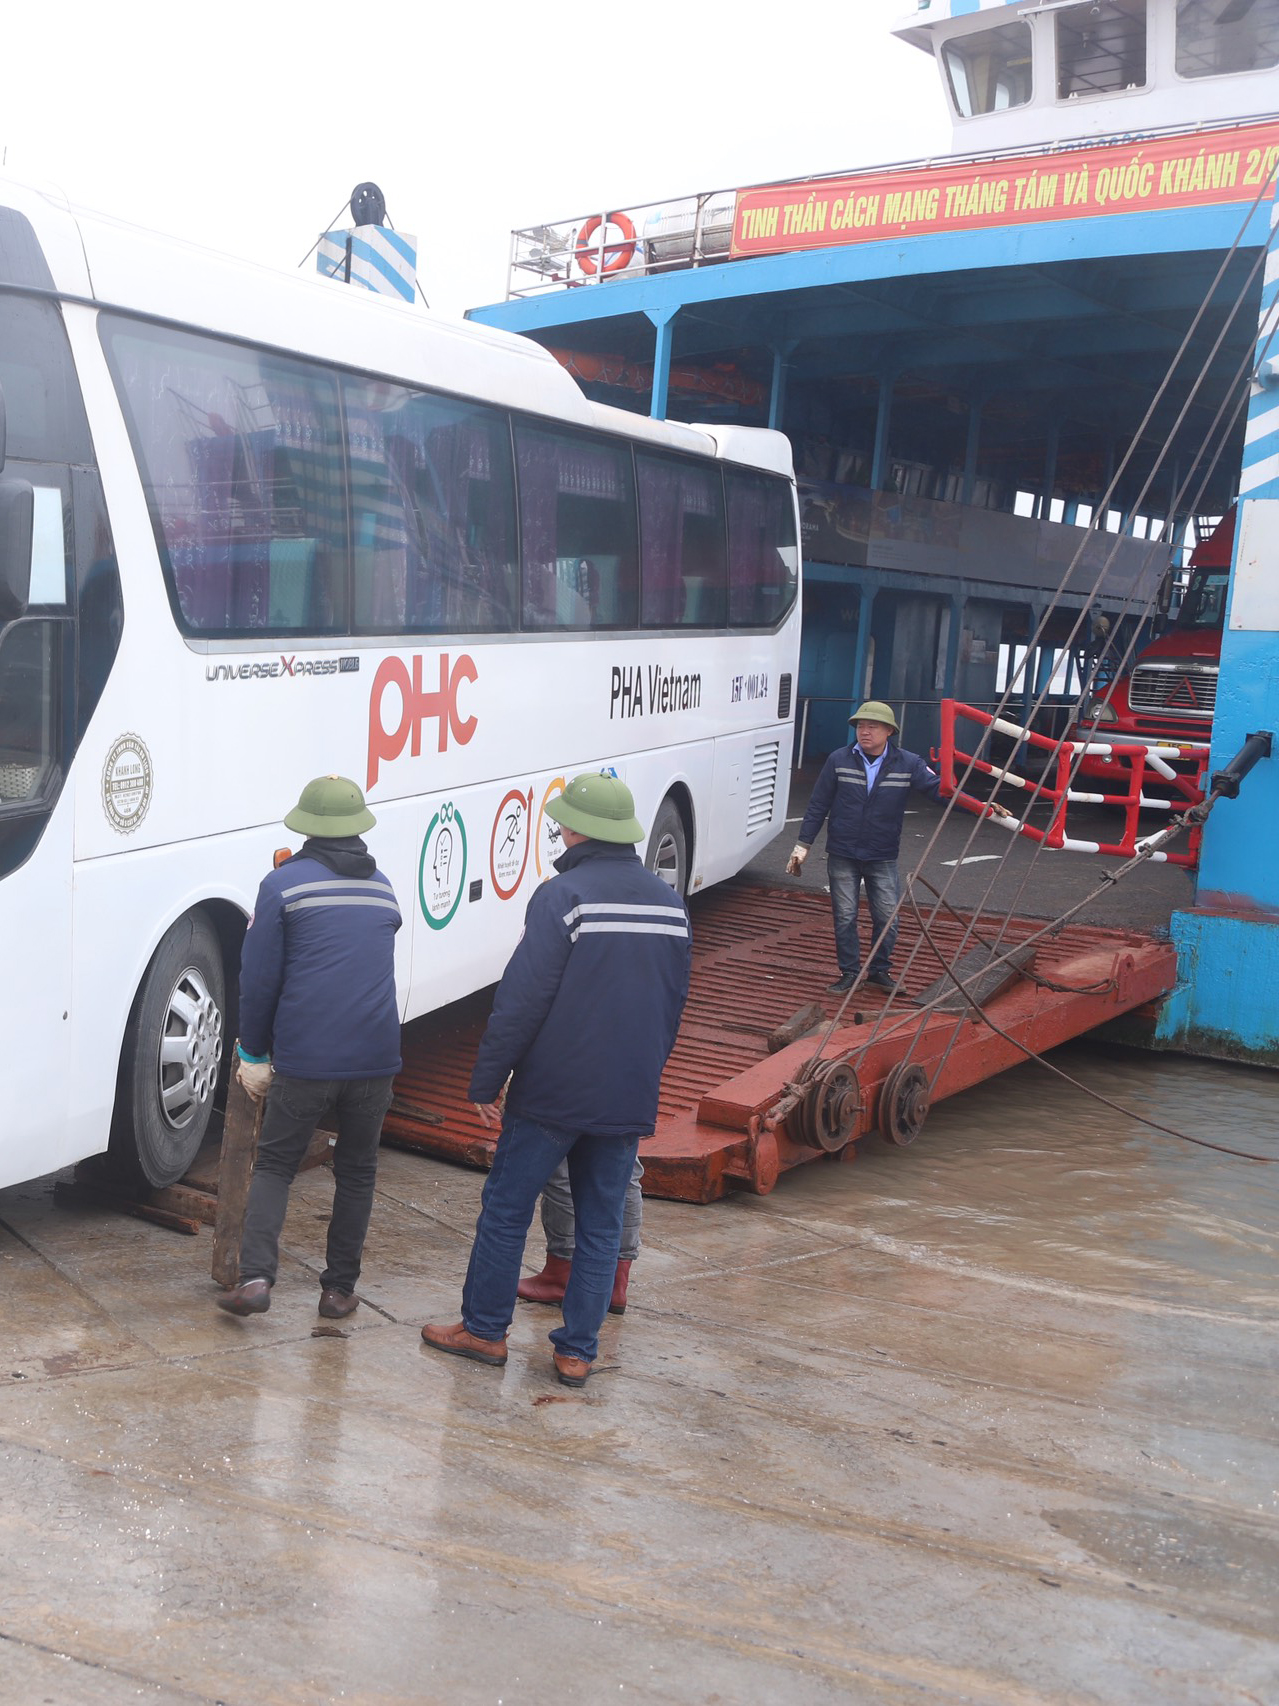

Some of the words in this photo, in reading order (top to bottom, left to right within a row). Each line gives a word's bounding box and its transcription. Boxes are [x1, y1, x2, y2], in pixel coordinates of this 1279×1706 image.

[741, 206, 779, 240] TINH
[782, 192, 828, 235] THẦN
[830, 191, 880, 231] CÁCH
[882, 188, 940, 230] MẠNG
[944, 176, 1009, 218] THÁNG
[1014, 169, 1059, 211] TÁM
[1063, 163, 1089, 206] VÀ
[1094, 151, 1155, 206] QUỐC
[1158, 148, 1240, 195] KHÁNH
[366, 653, 479, 793] PHC
[610, 665, 643, 719] PHA
[648, 664, 701, 715] Vietnam
